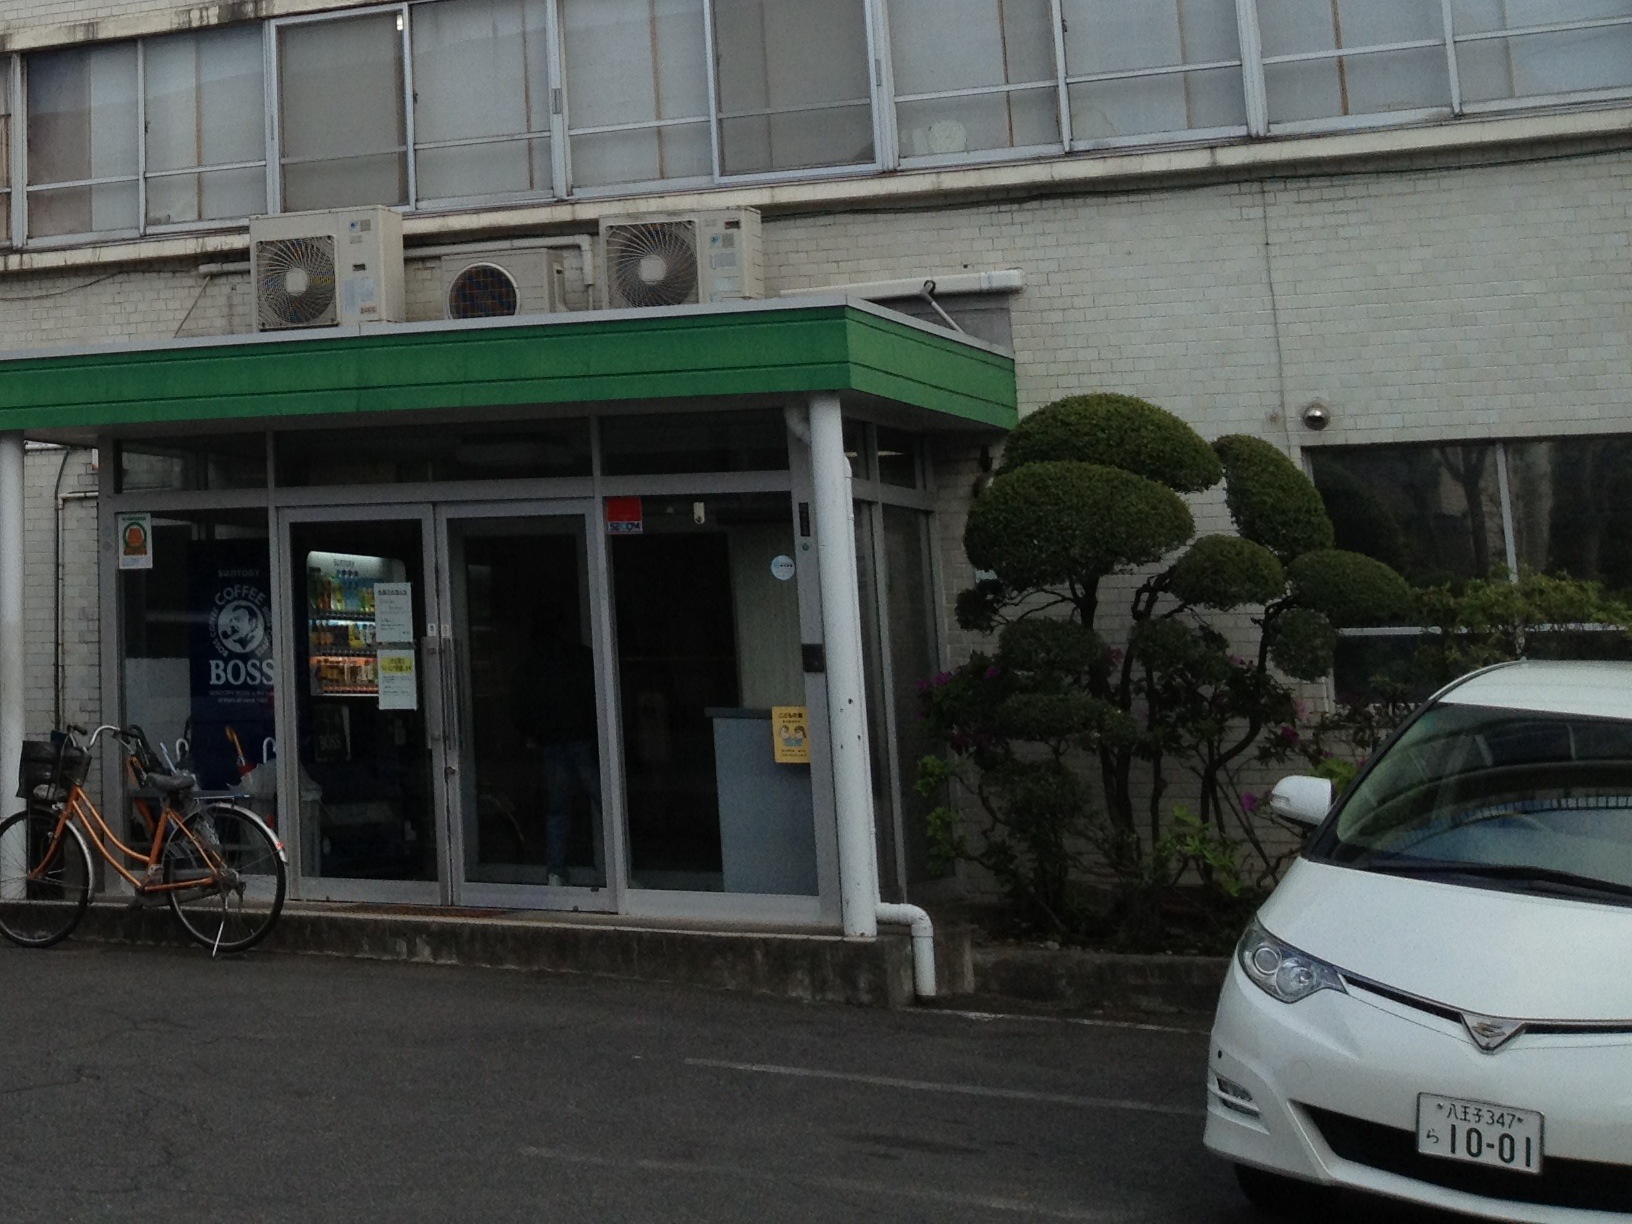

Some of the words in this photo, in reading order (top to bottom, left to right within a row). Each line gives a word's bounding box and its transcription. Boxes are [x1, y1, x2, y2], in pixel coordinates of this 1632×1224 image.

[214, 584, 266, 606] COFFEE
[208, 659, 275, 685] BOSS
[1447, 1102, 1483, 1124] 八王子
[1486, 1109, 1517, 1129] 347
[1426, 1127, 1440, 1144] ら
[1450, 1123, 1531, 1168] 10-01
